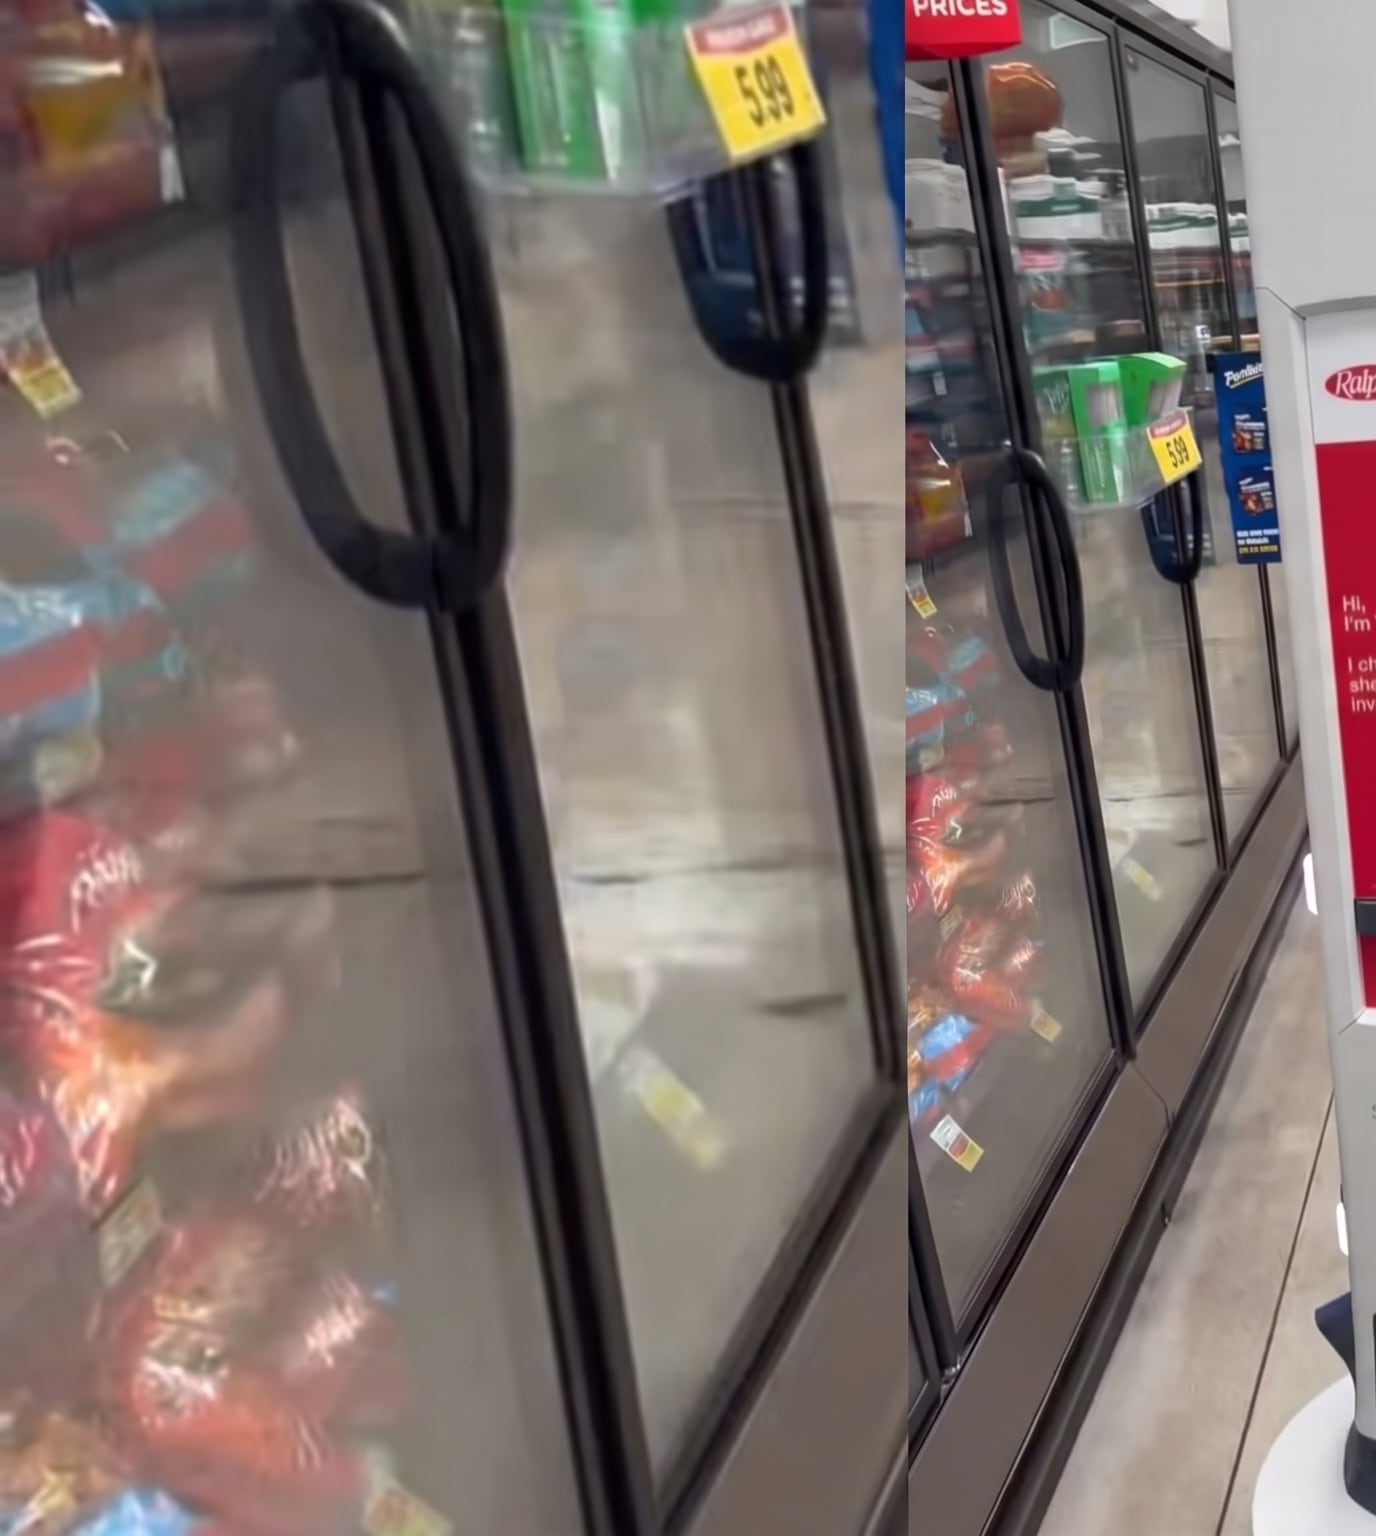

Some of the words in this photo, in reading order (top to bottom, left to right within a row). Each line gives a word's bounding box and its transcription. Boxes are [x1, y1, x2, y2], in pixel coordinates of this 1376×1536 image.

[912, 0, 1009, 18] PRICES
[1342, 595, 1366, 614] Hi,
[1344, 615, 1371, 632] I'm
[1347, 656, 1353, 674] I
